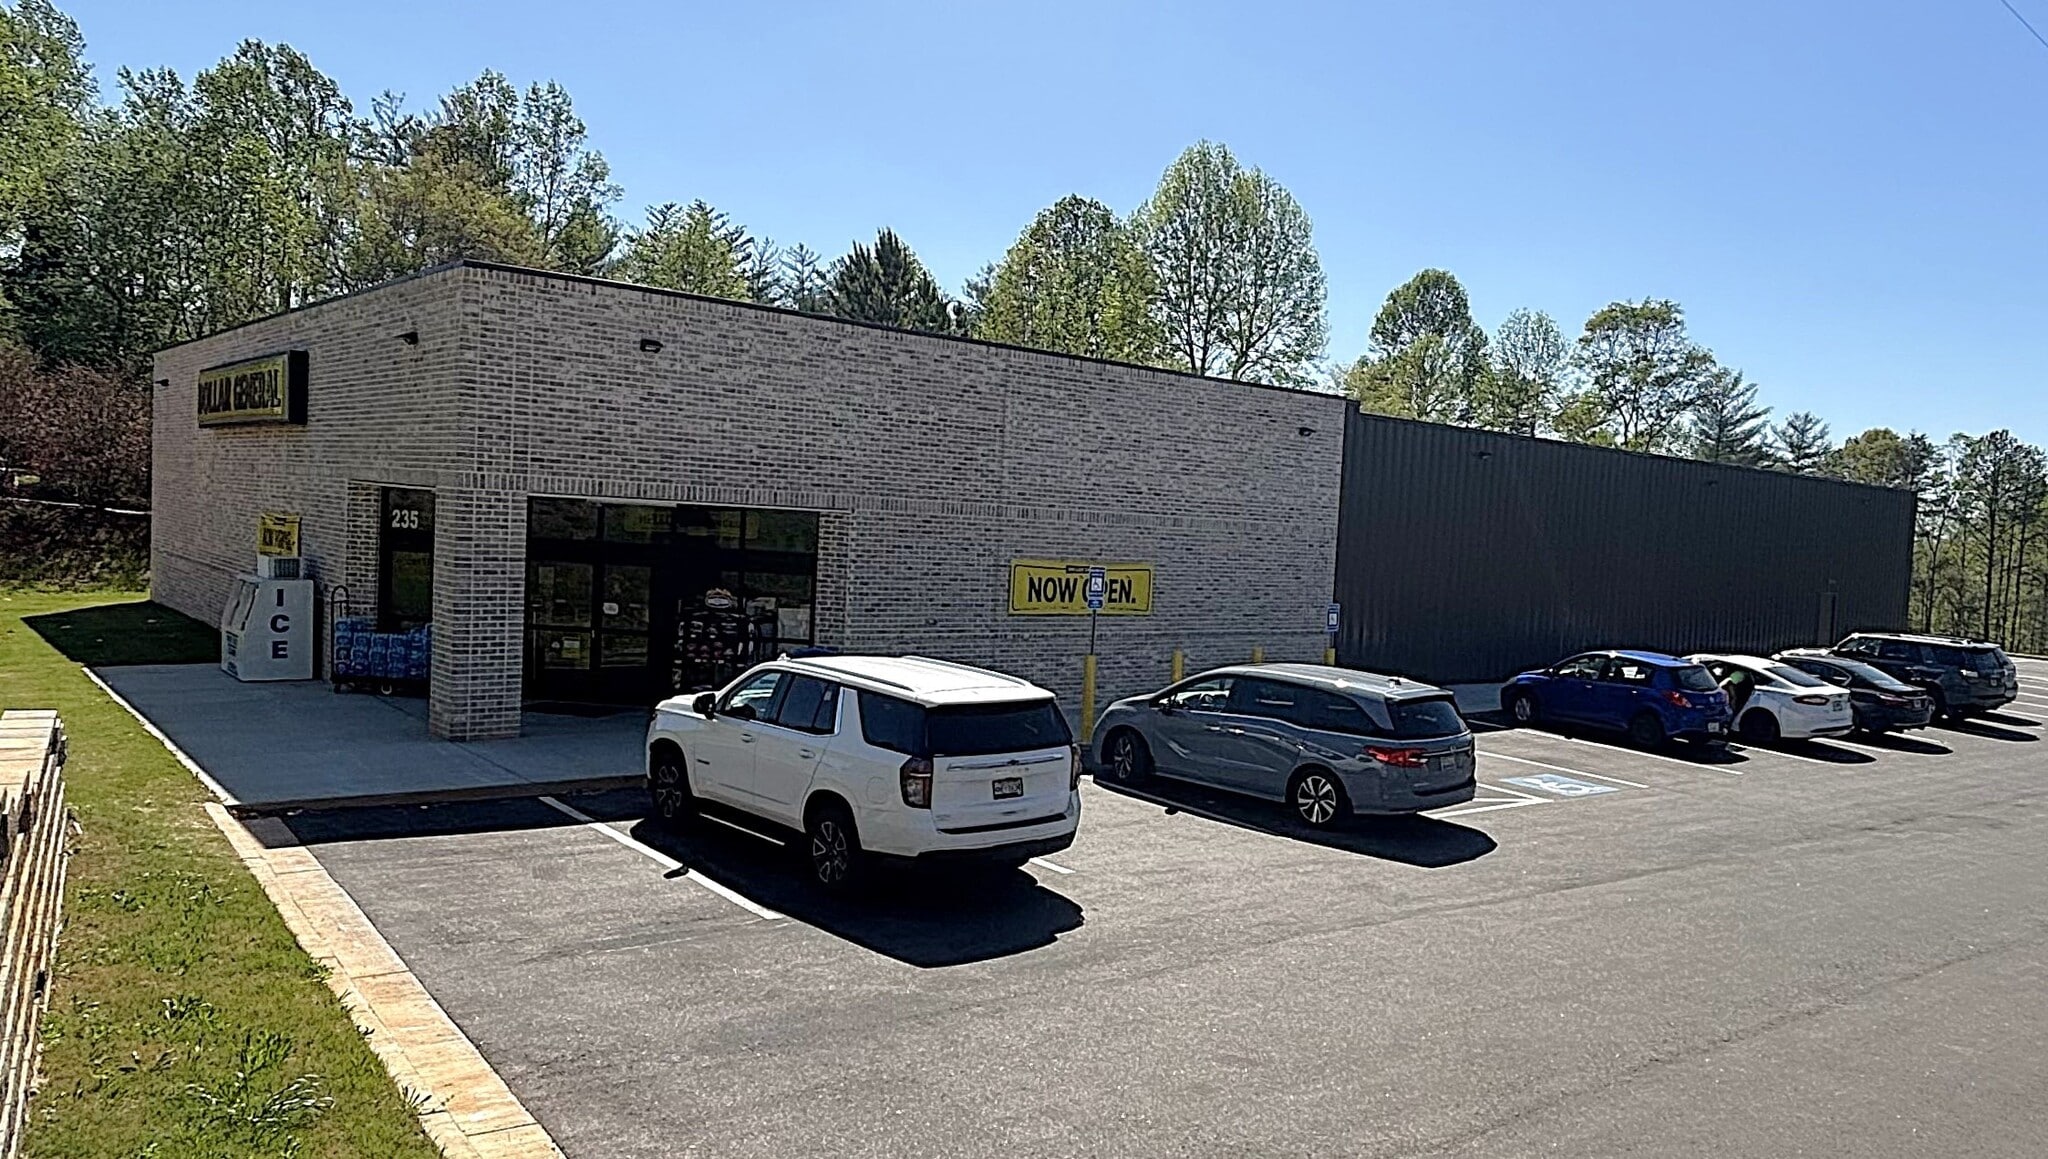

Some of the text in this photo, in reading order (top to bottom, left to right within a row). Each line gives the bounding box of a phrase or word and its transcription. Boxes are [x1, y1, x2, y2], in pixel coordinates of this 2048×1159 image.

[234, 369, 282, 411] GENERAL
[391, 509, 419, 529] 235
[1027, 576, 1078, 603] NOW
[270, 588, 290, 659] ICE
